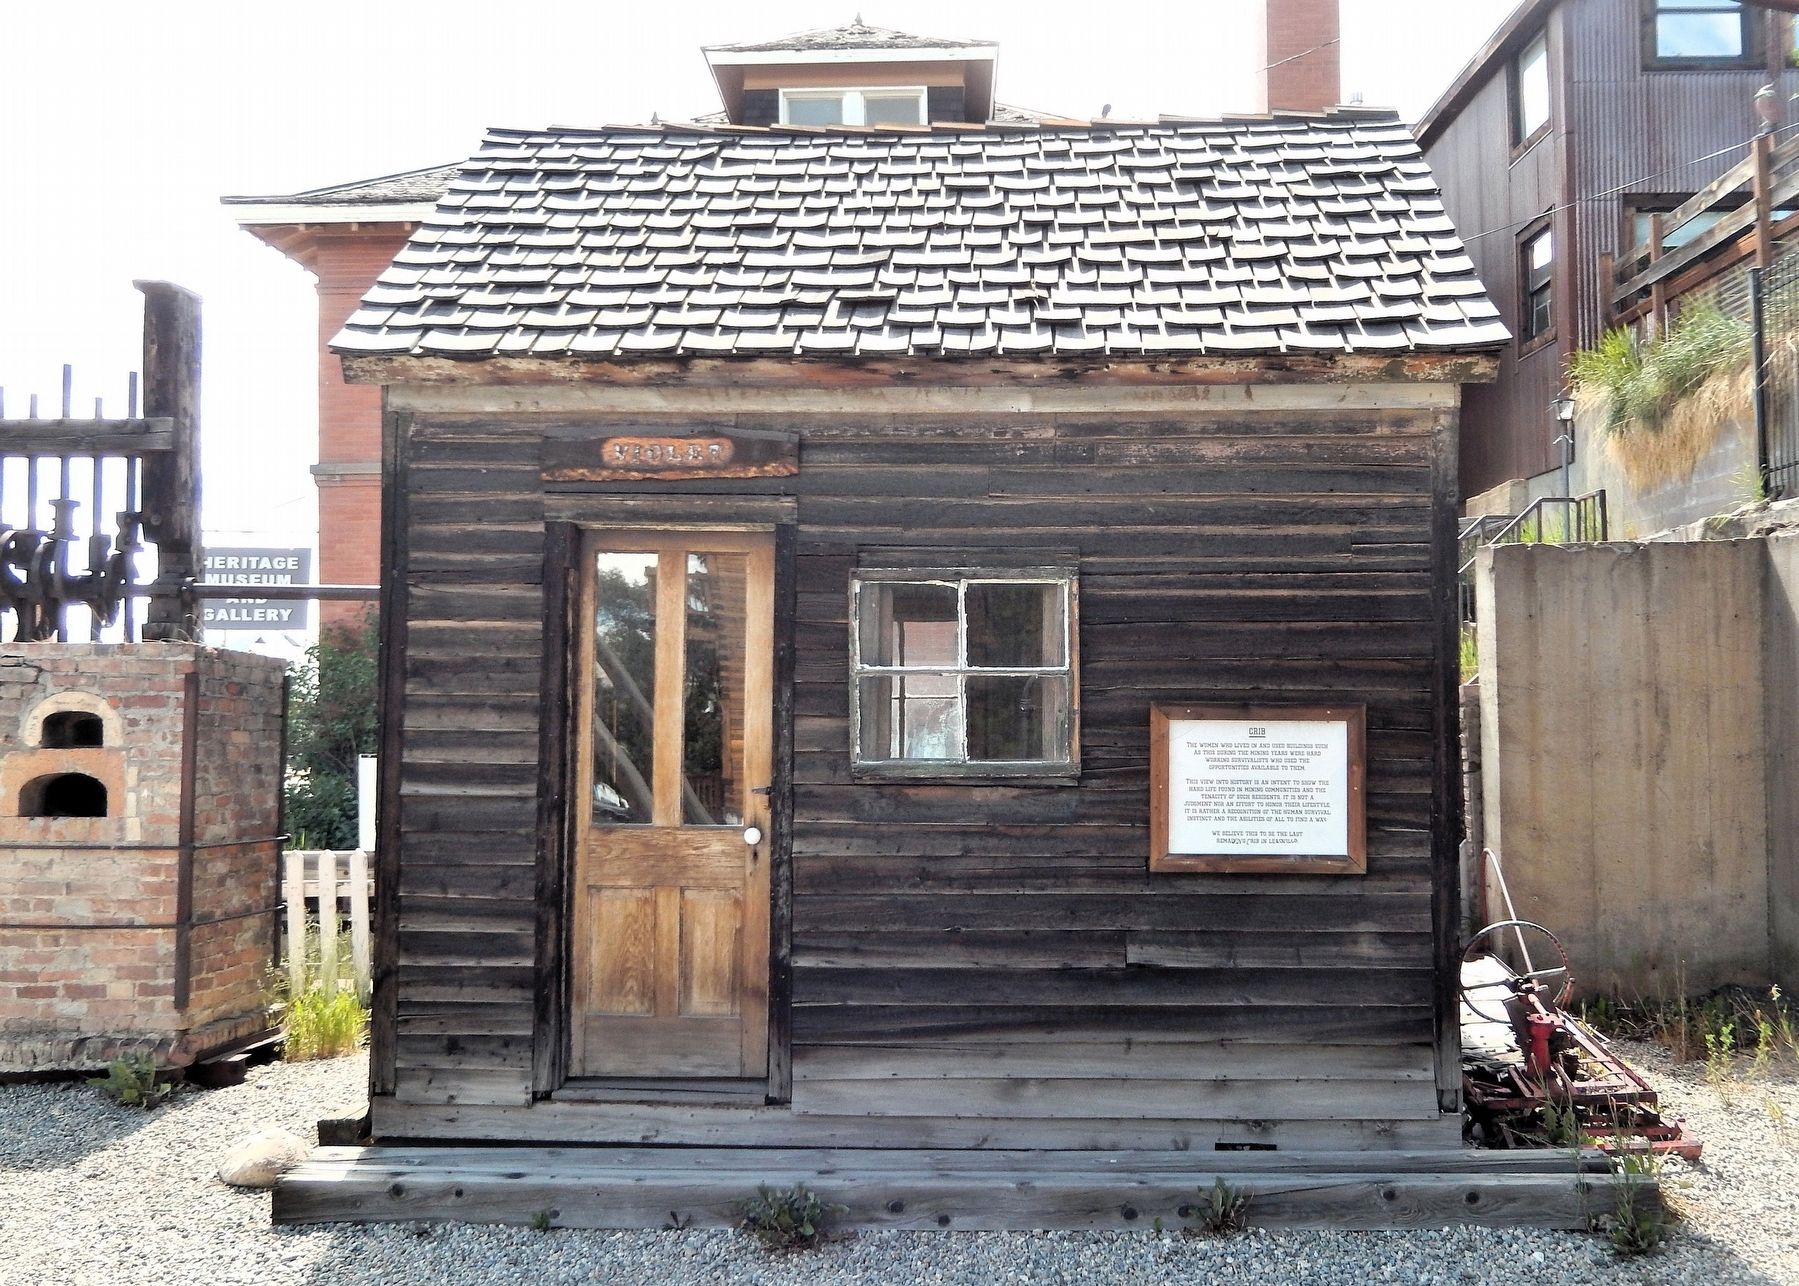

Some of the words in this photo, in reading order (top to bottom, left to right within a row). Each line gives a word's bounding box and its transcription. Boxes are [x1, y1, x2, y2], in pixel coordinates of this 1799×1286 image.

[204, 557, 298, 569] HERITAGE
[205, 573, 291, 584] MUSEUM
[204, 608, 293, 621] GALLERY
[1249, 727, 1265, 735] CRIB
